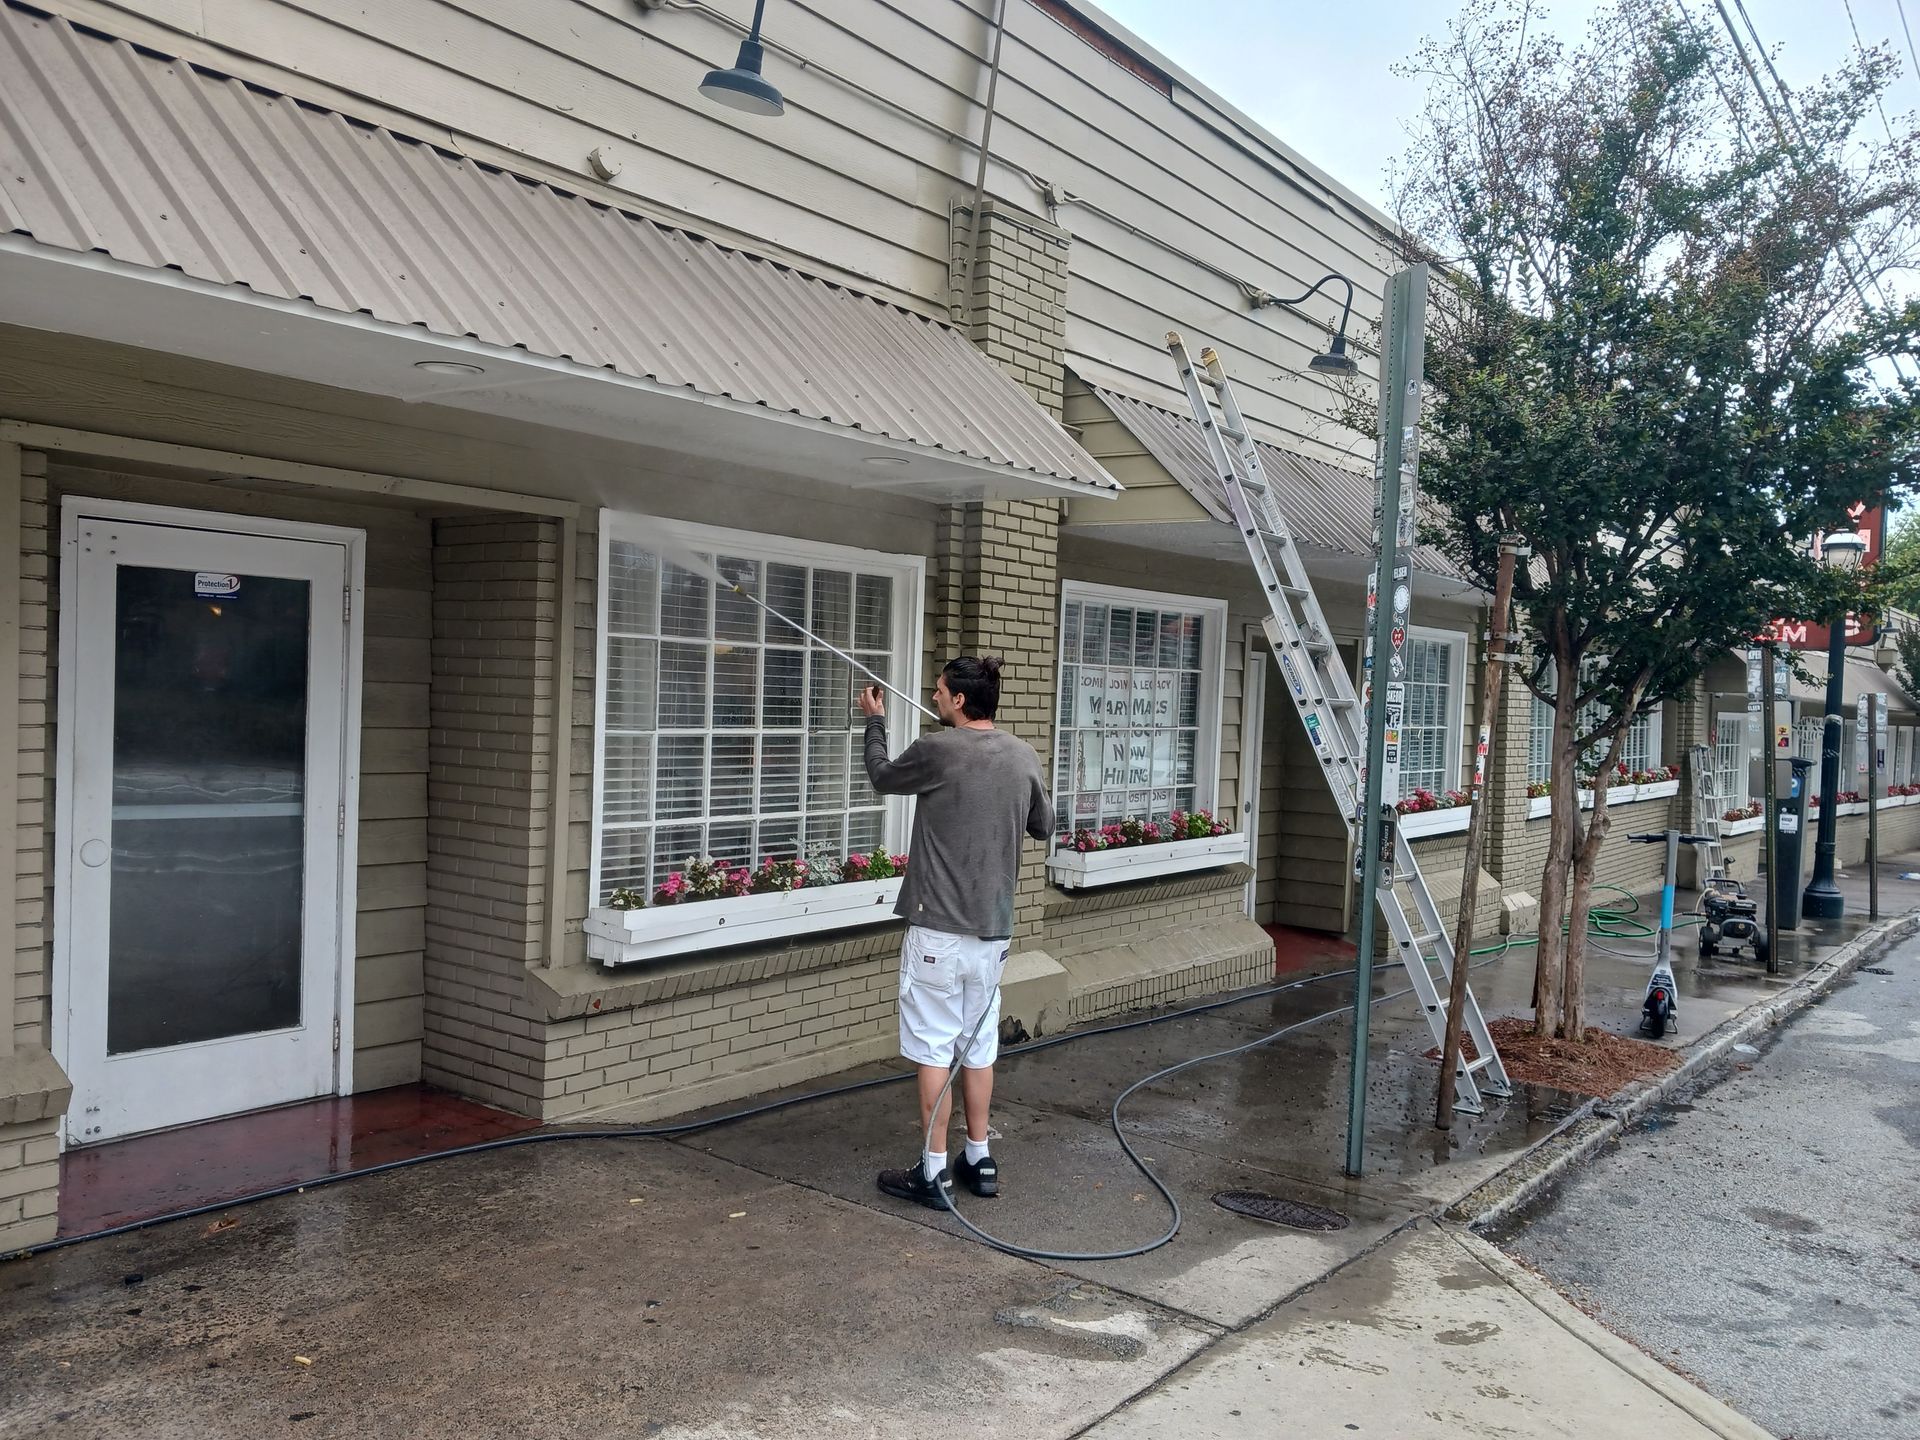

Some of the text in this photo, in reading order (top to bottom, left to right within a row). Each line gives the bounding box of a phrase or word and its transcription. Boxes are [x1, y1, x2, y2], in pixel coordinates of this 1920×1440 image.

[1286, 661, 1300, 688] WERNER
[1081, 676, 1103, 689] OM
[1109, 679, 1129, 690] JOIN
[1113, 743, 1146, 761] NW
[1105, 794, 1122, 805] ALL
[1127, 790, 1167, 803] OSITONS
